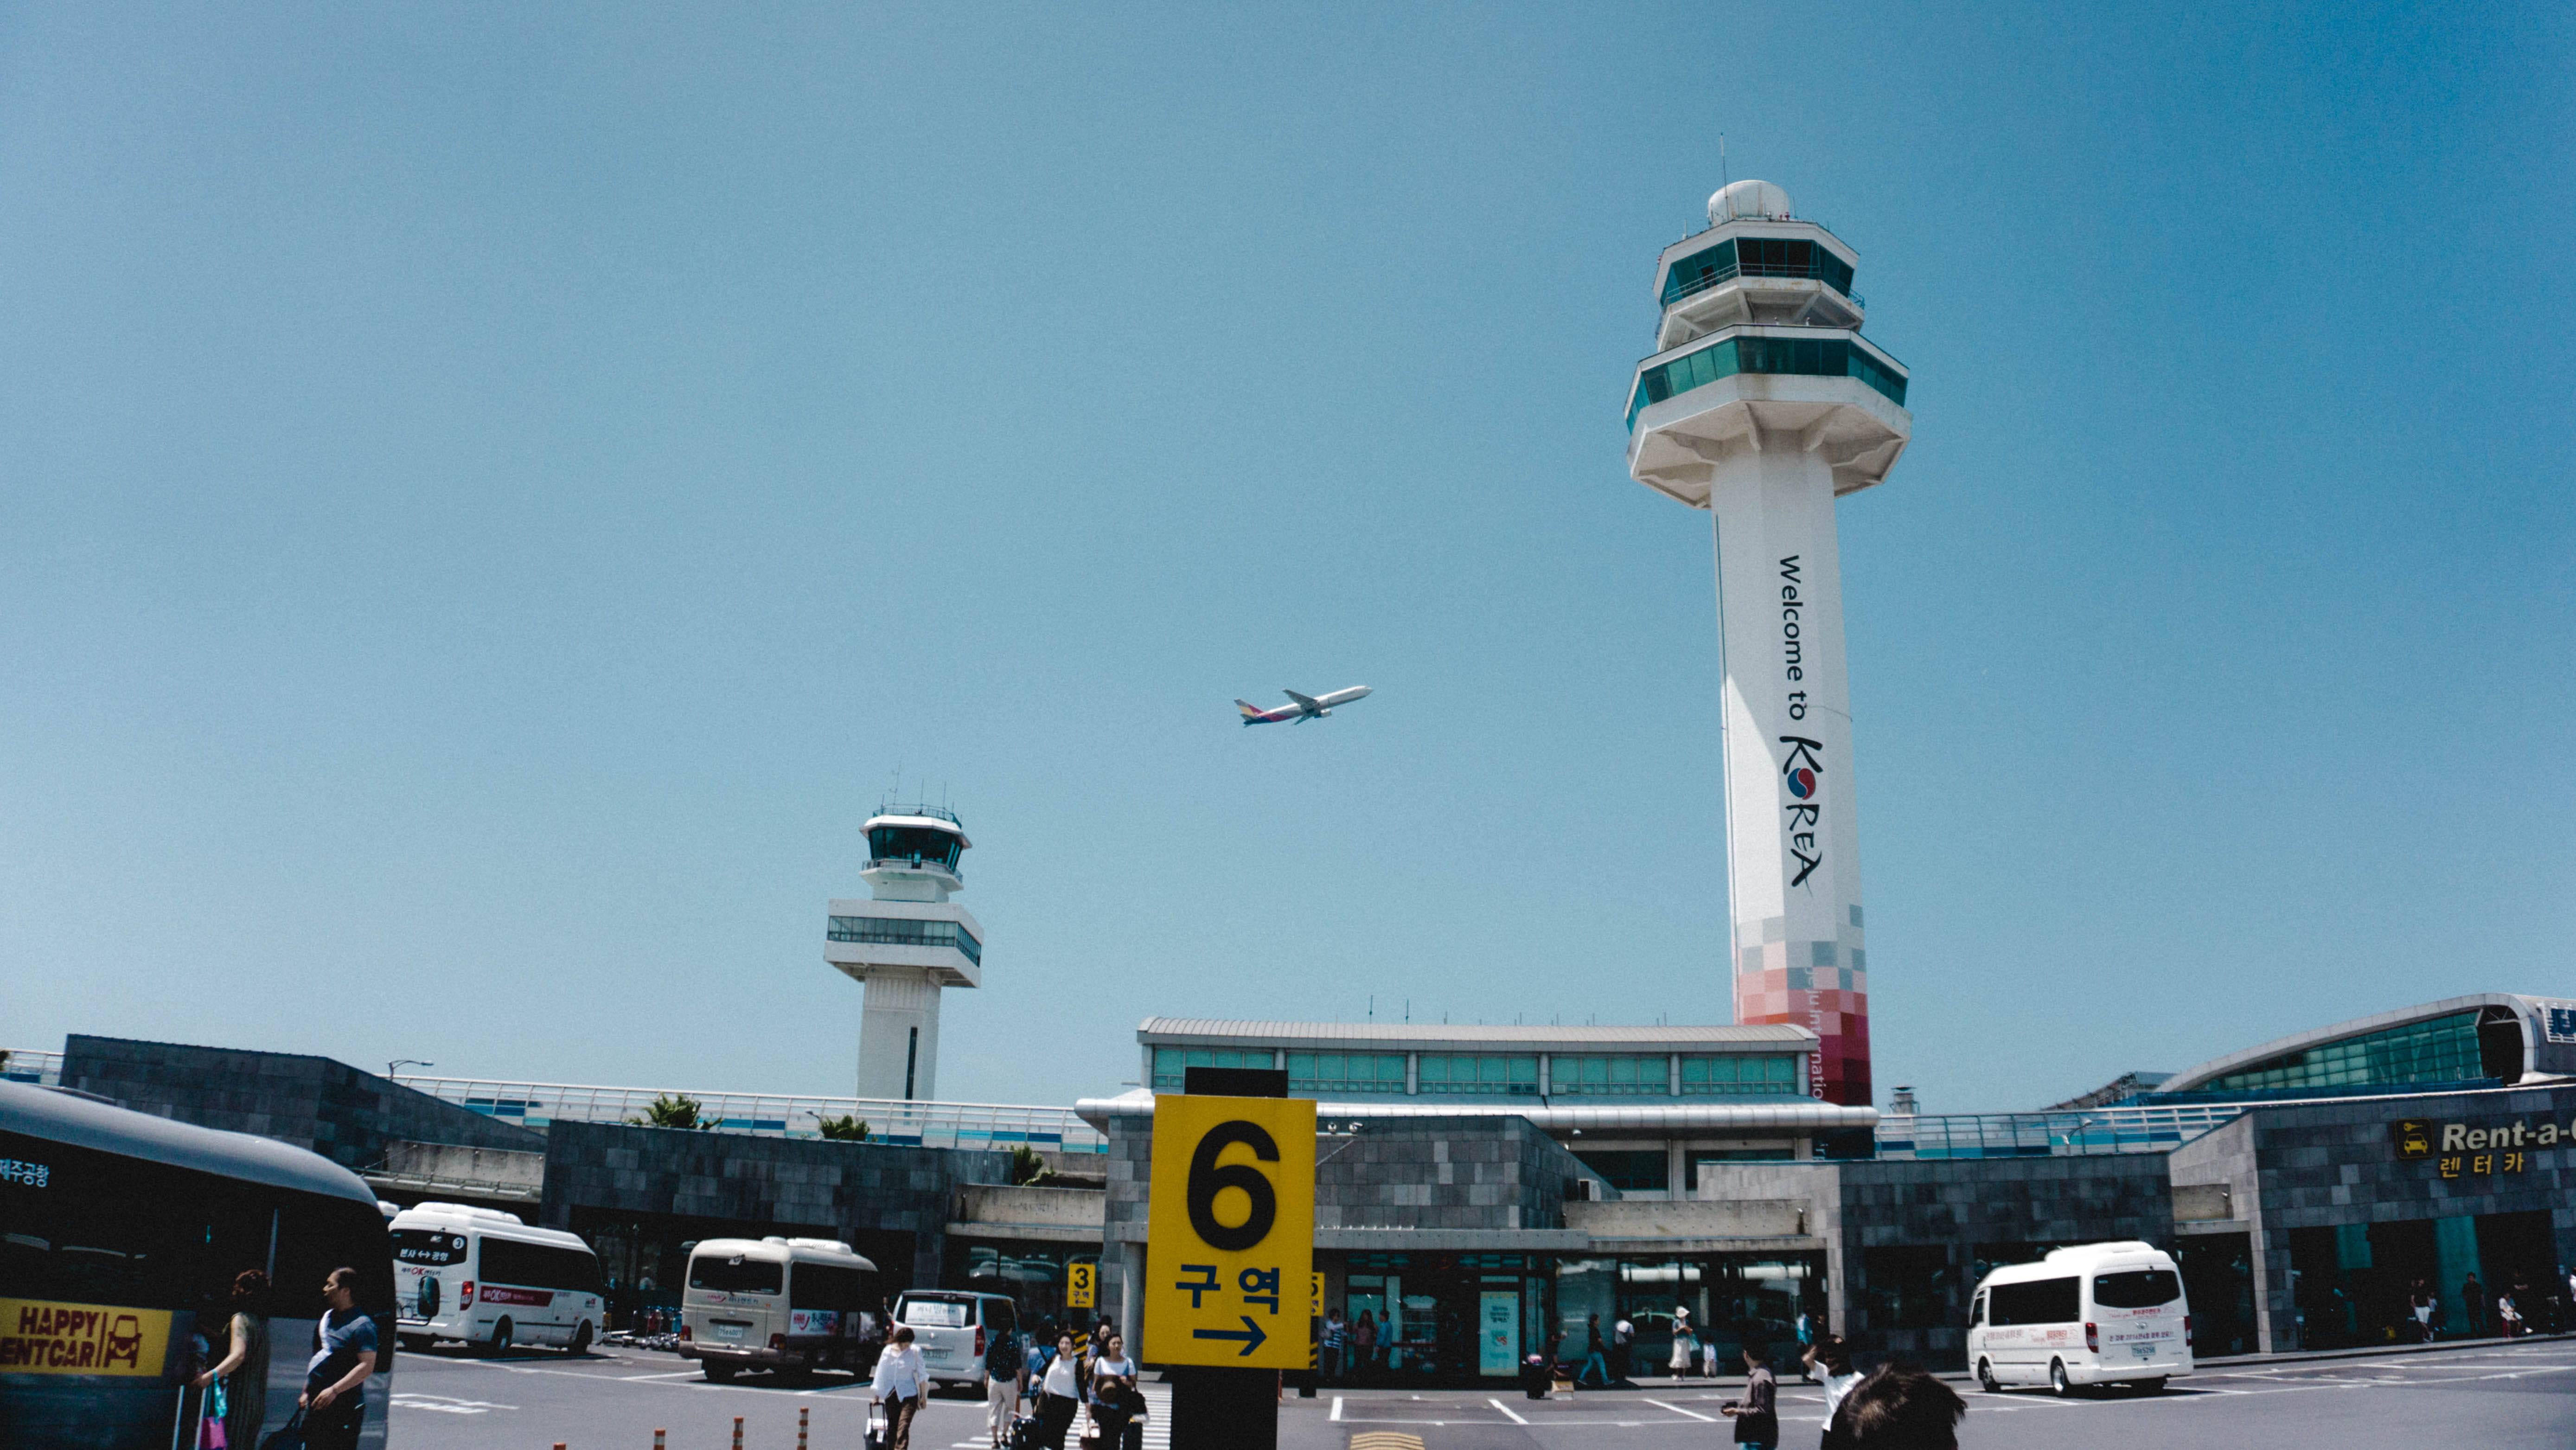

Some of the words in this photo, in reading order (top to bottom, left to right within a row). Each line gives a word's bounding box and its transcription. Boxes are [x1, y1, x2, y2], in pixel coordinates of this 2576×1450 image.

[1780, 555, 1803, 681] Welcome
[1789, 690, 1807, 720] to
[2442, 1120, 2576, 1152] Rent-a-
[1187, 1120, 1280, 1251] 6
[1074, 1268, 1089, 1289] 3
[19, 1306, 100, 1338] HAPPY
